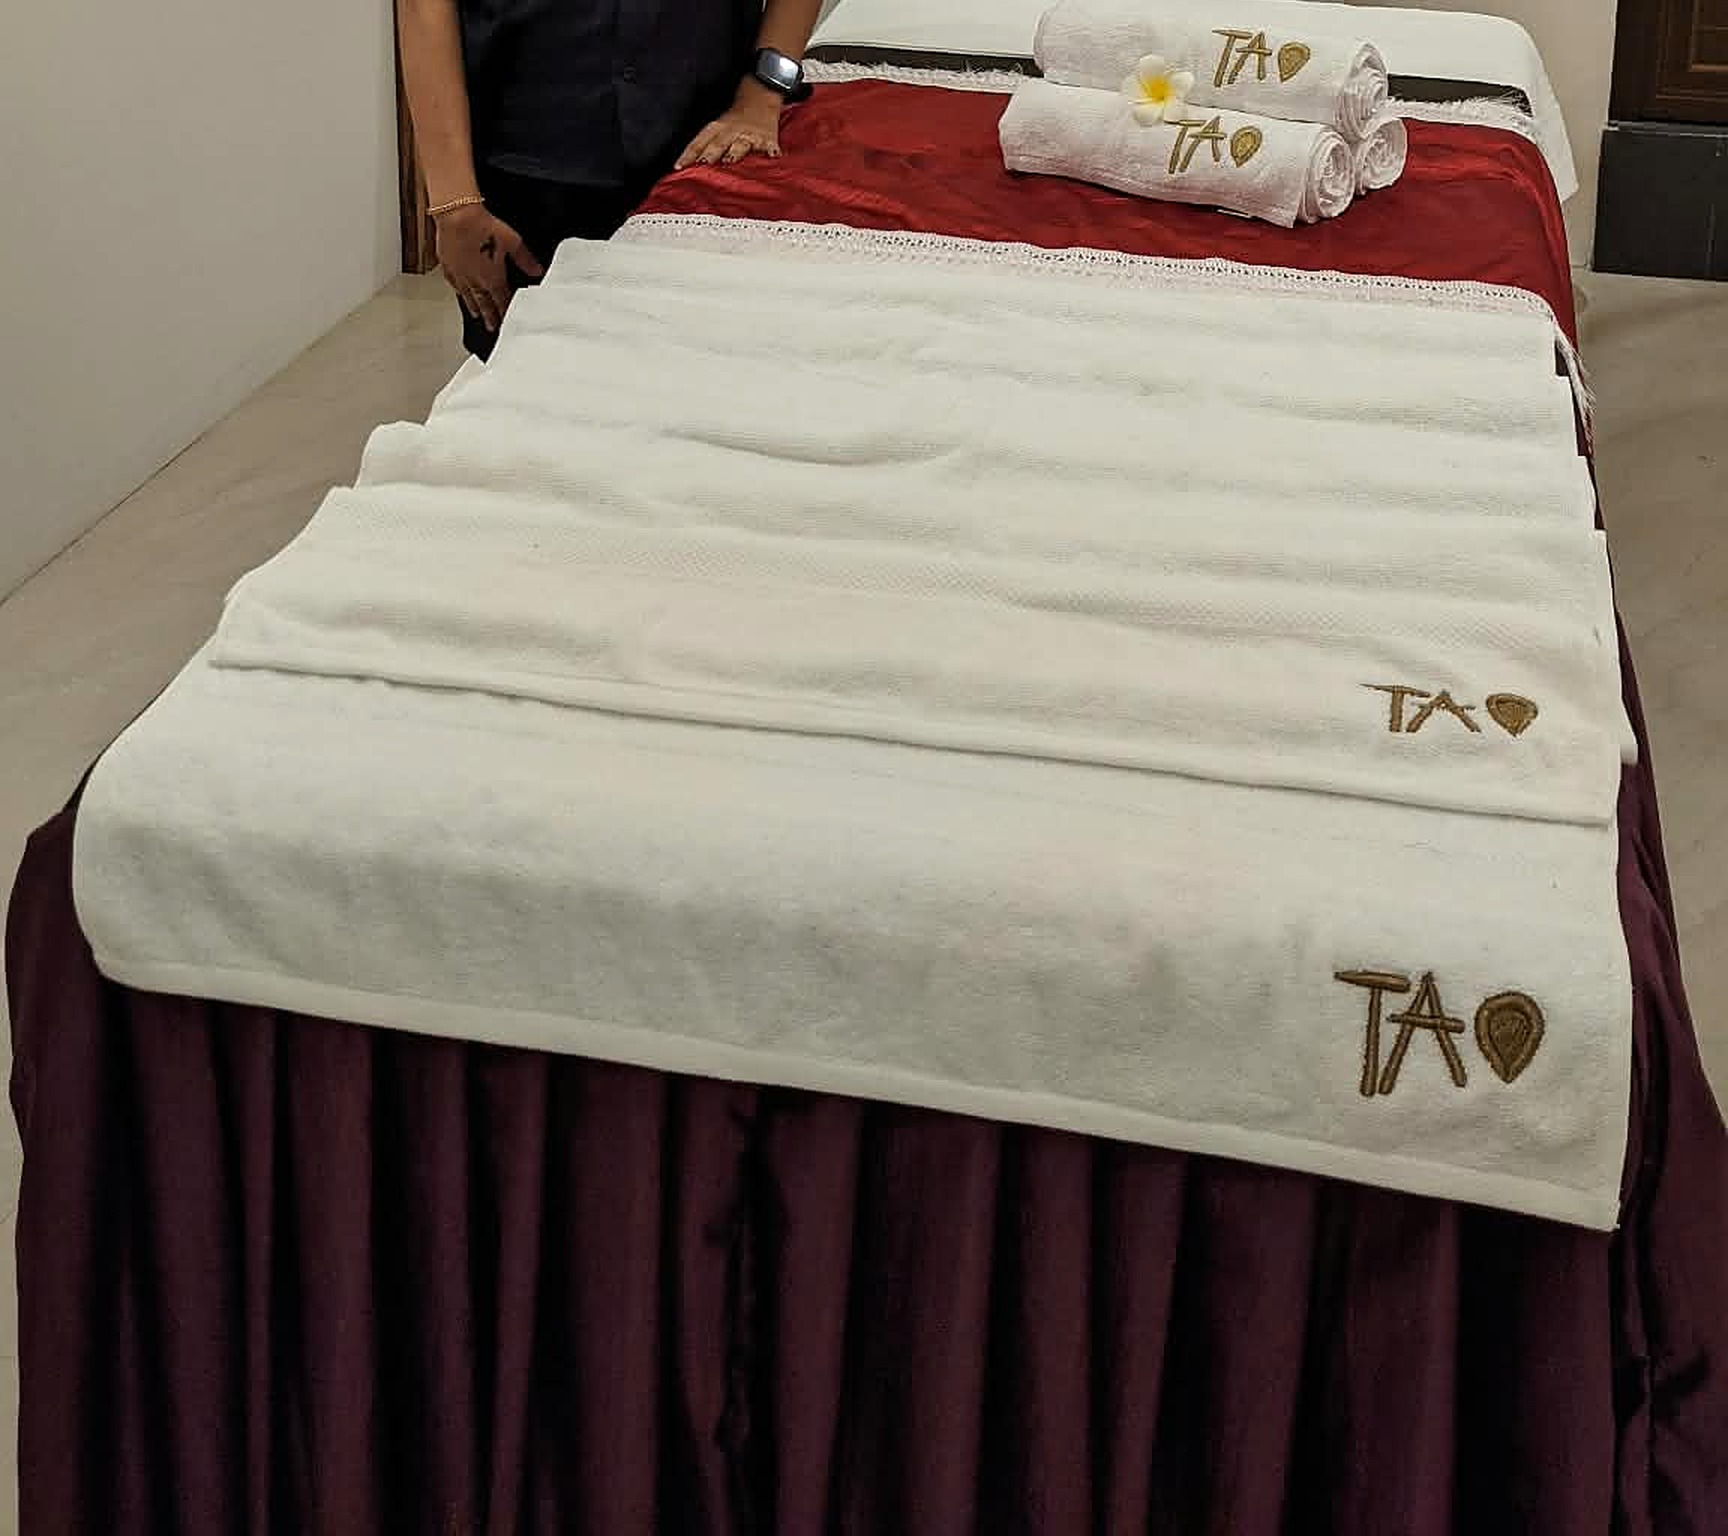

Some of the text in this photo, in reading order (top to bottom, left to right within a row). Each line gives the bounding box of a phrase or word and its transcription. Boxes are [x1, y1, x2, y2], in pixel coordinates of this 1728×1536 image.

[1211, 29, 1311, 88] TAO
[1163, 115, 1263, 174] TAO
[1360, 682, 1539, 738] TAO
[1334, 971, 1546, 1097] TAO
